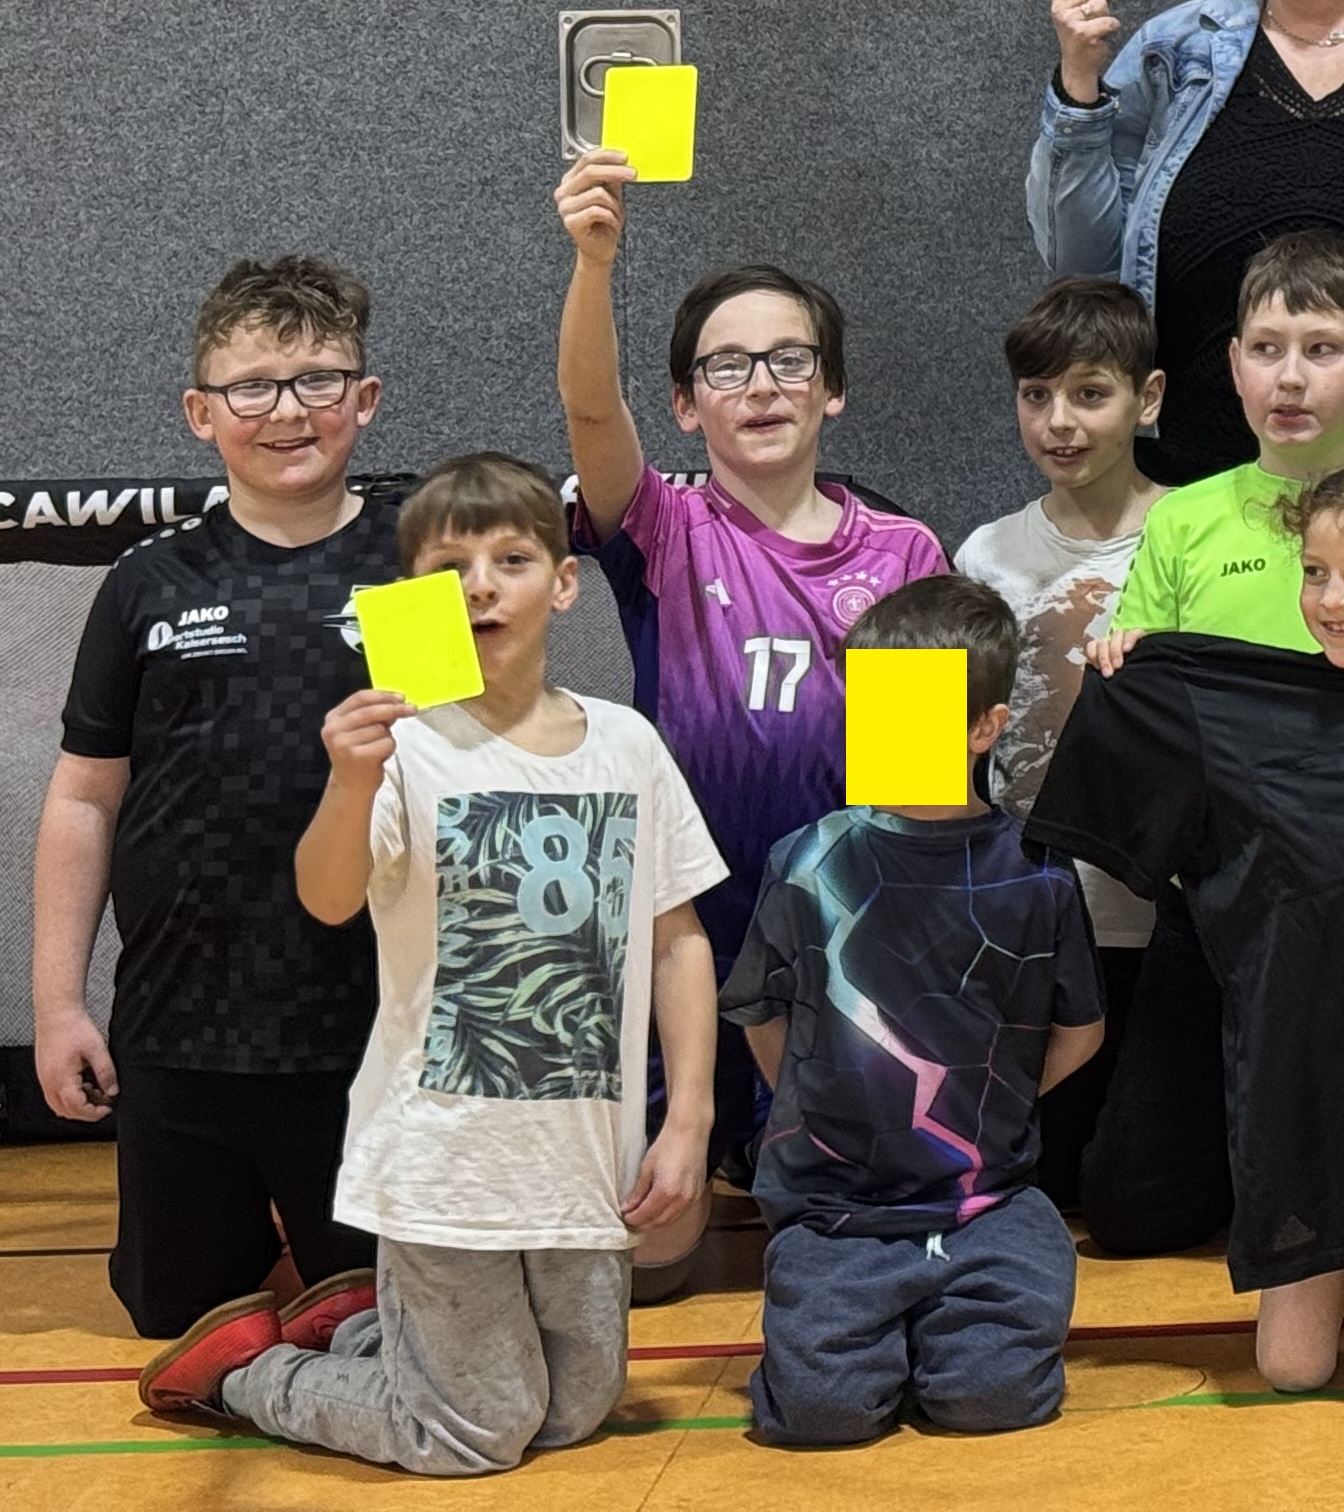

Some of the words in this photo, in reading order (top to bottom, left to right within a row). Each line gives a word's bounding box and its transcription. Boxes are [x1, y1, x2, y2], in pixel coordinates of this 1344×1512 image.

[1220, 558, 1267, 577] JAKO
[178, 605, 229, 627] JAKO
[743, 636, 812, 713] 17
